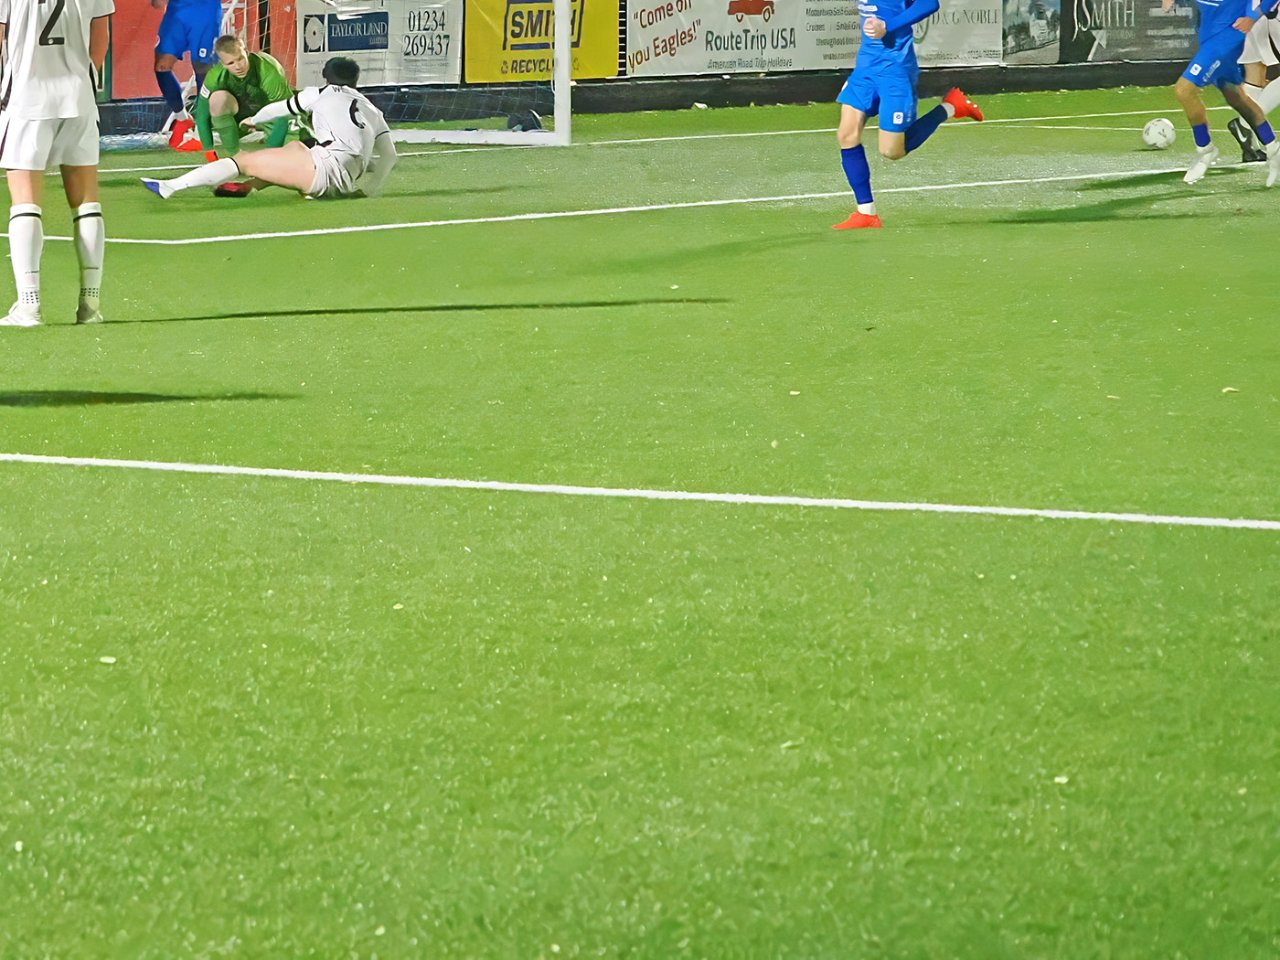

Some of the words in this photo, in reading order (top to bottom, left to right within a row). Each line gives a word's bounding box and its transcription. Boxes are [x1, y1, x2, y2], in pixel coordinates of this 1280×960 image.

[408, 10, 446, 32] 01234
[404, 34, 450, 57] 269437
[771, 27, 797, 50] USA
[511, 58, 555, 74] RECYCL
[628, 46, 650, 74] you
